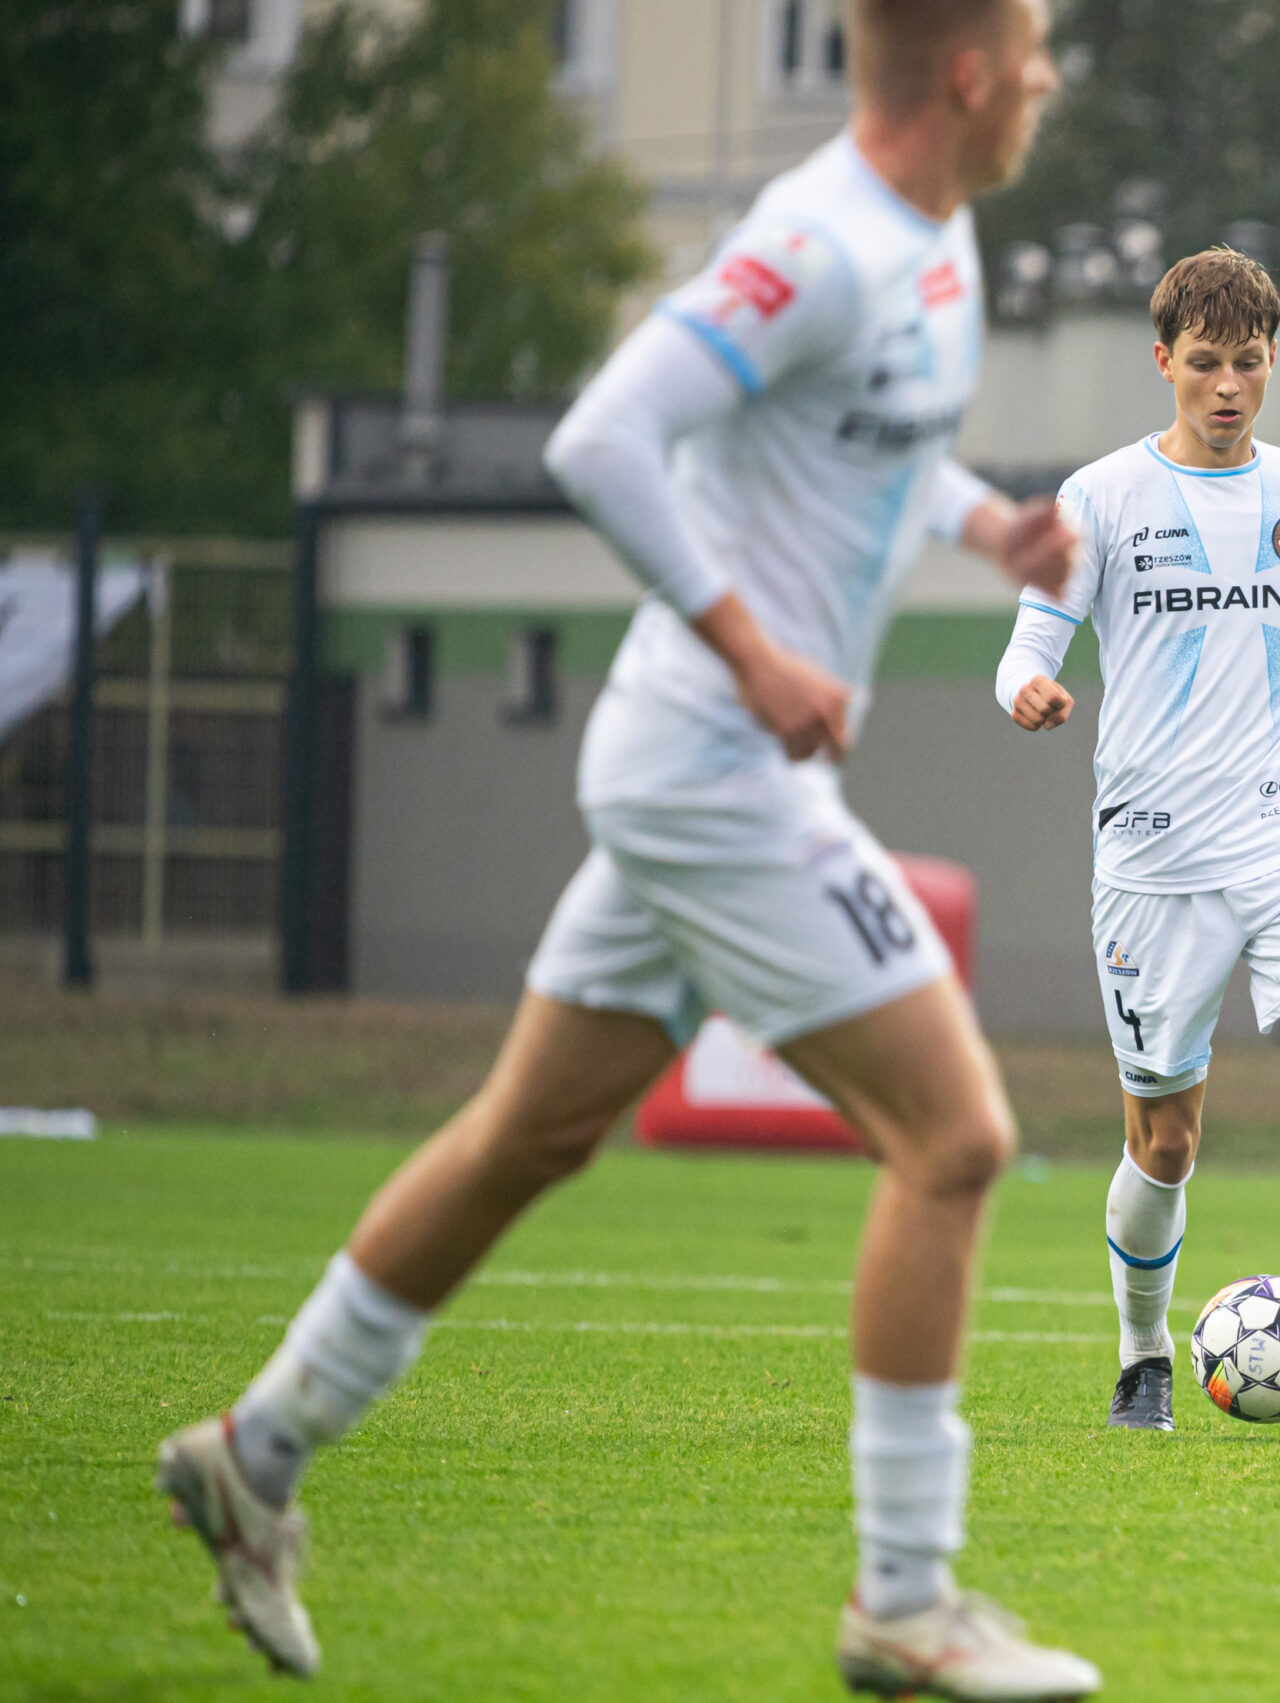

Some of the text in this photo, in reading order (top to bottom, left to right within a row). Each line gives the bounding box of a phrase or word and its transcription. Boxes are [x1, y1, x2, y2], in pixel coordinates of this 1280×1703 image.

[1154, 528, 1190, 539] CUNA
[1154, 554, 1192, 563] rzeszów
[824, 869, 917, 964] 18
[1114, 989, 1144, 1051] 4
[1125, 1071, 1158, 1083] CUNA
